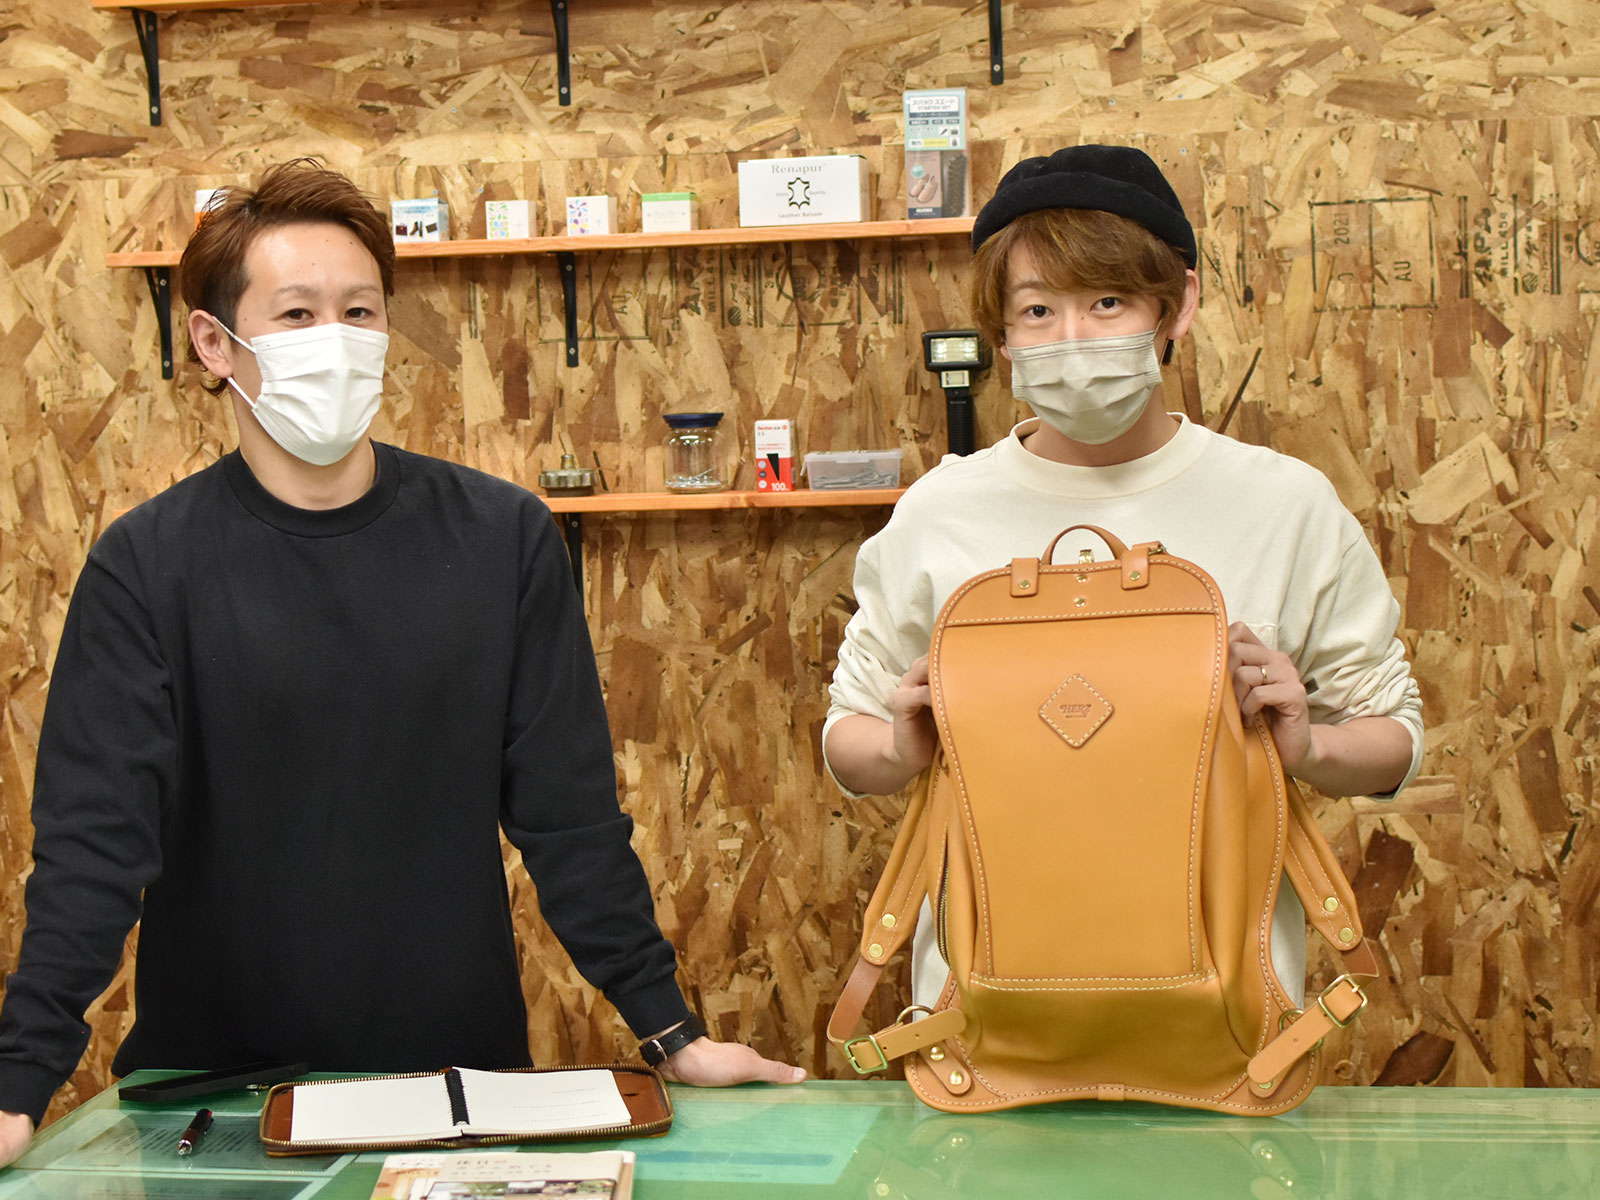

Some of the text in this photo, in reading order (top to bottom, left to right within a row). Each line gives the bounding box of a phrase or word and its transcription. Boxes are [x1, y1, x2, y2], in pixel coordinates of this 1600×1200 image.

[771, 163, 823, 175] Renapur
[1334, 212, 1351, 246] 2021
[1500, 241, 1509, 278] MILL
[1394, 260, 1412, 282] AU
[611, 293, 628, 316] AU
[707, 277, 717, 313] MILL
[771, 481, 786, 491] 100
[1060, 704, 1092, 716] HERZ
